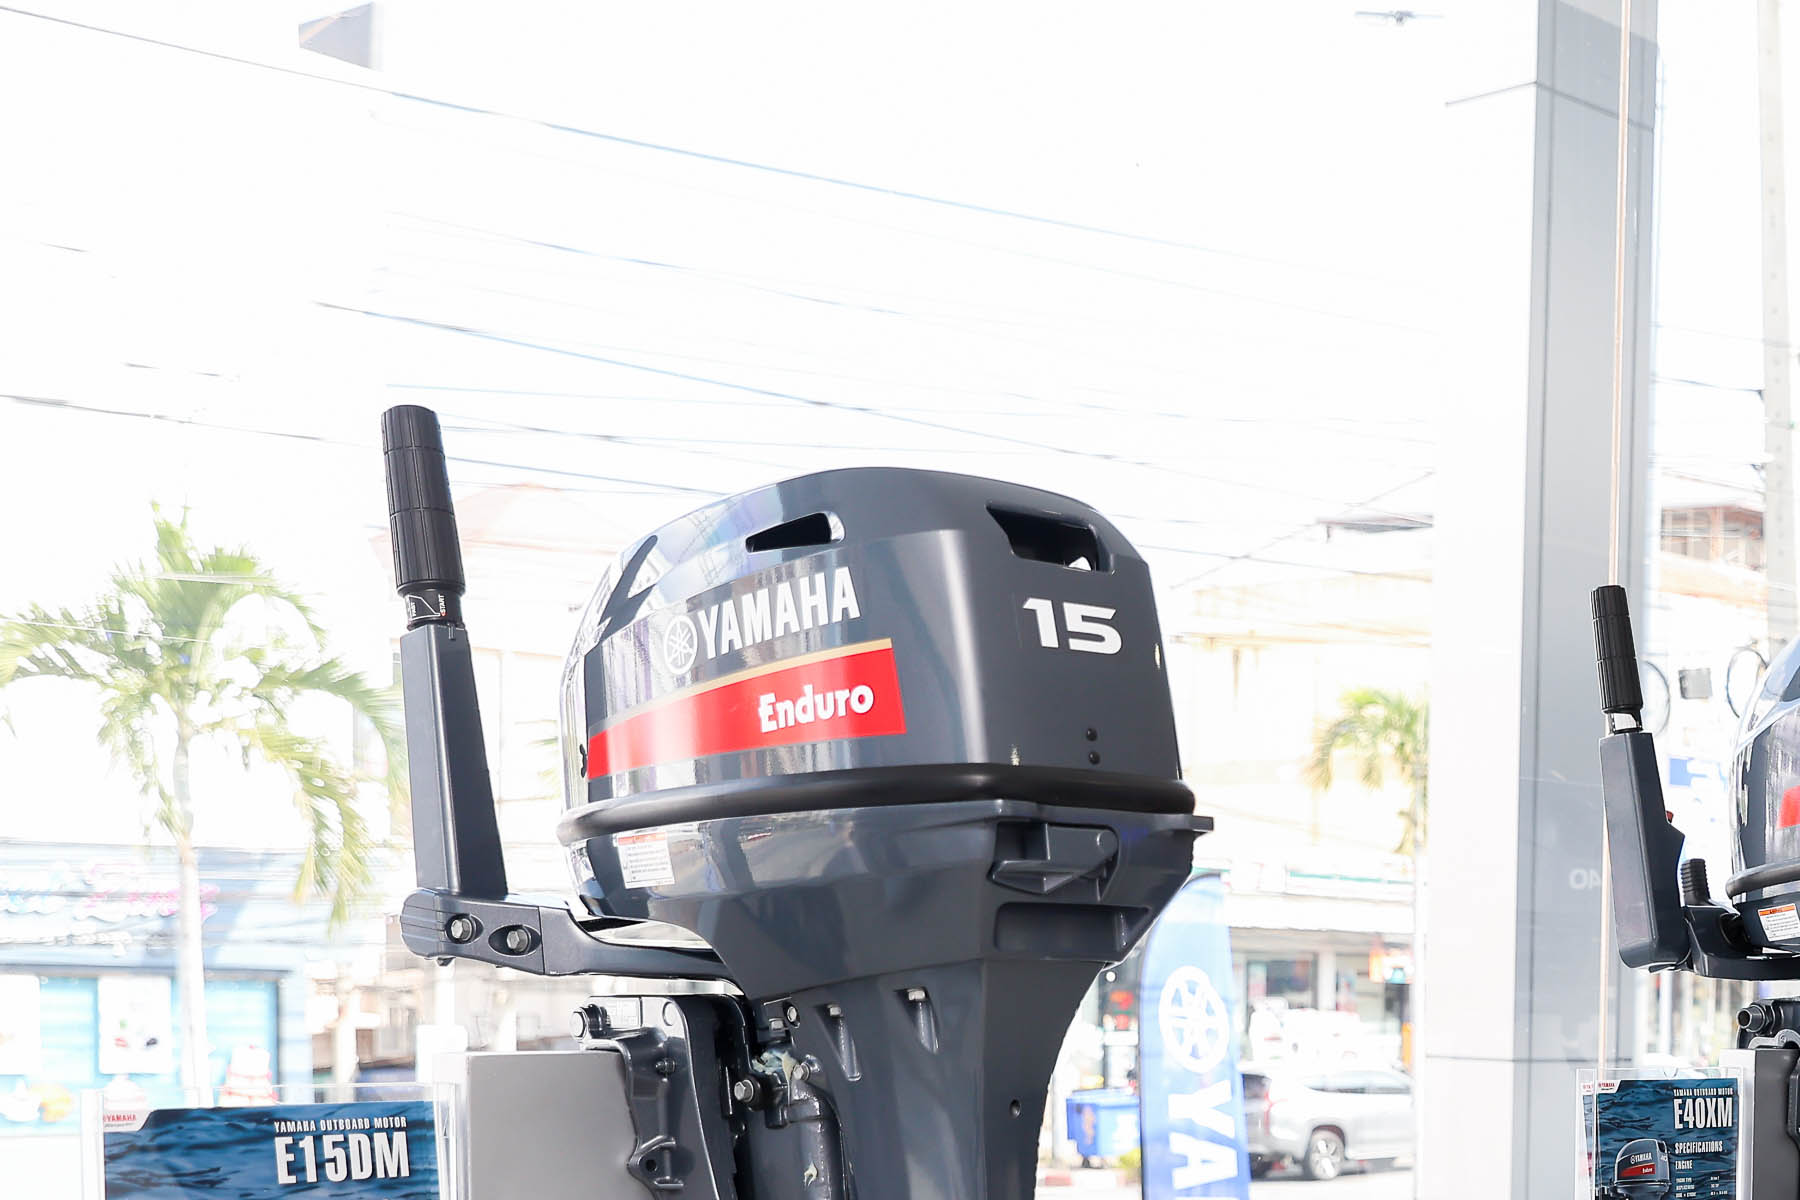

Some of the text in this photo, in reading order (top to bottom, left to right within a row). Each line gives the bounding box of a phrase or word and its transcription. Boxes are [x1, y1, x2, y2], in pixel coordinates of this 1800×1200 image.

[697, 567, 861, 660] YAMAHA
[1023, 597, 1122, 655] 15
[758, 684, 875, 734] Enduro
[274, 1116, 407, 1133] YAMAHA OUTBOARD MOTOR
[1673, 1097, 1733, 1129] E40XM
[274, 1131, 410, 1184] E15DM
[1674, 1140, 1723, 1154] SPECIFICATIONS
